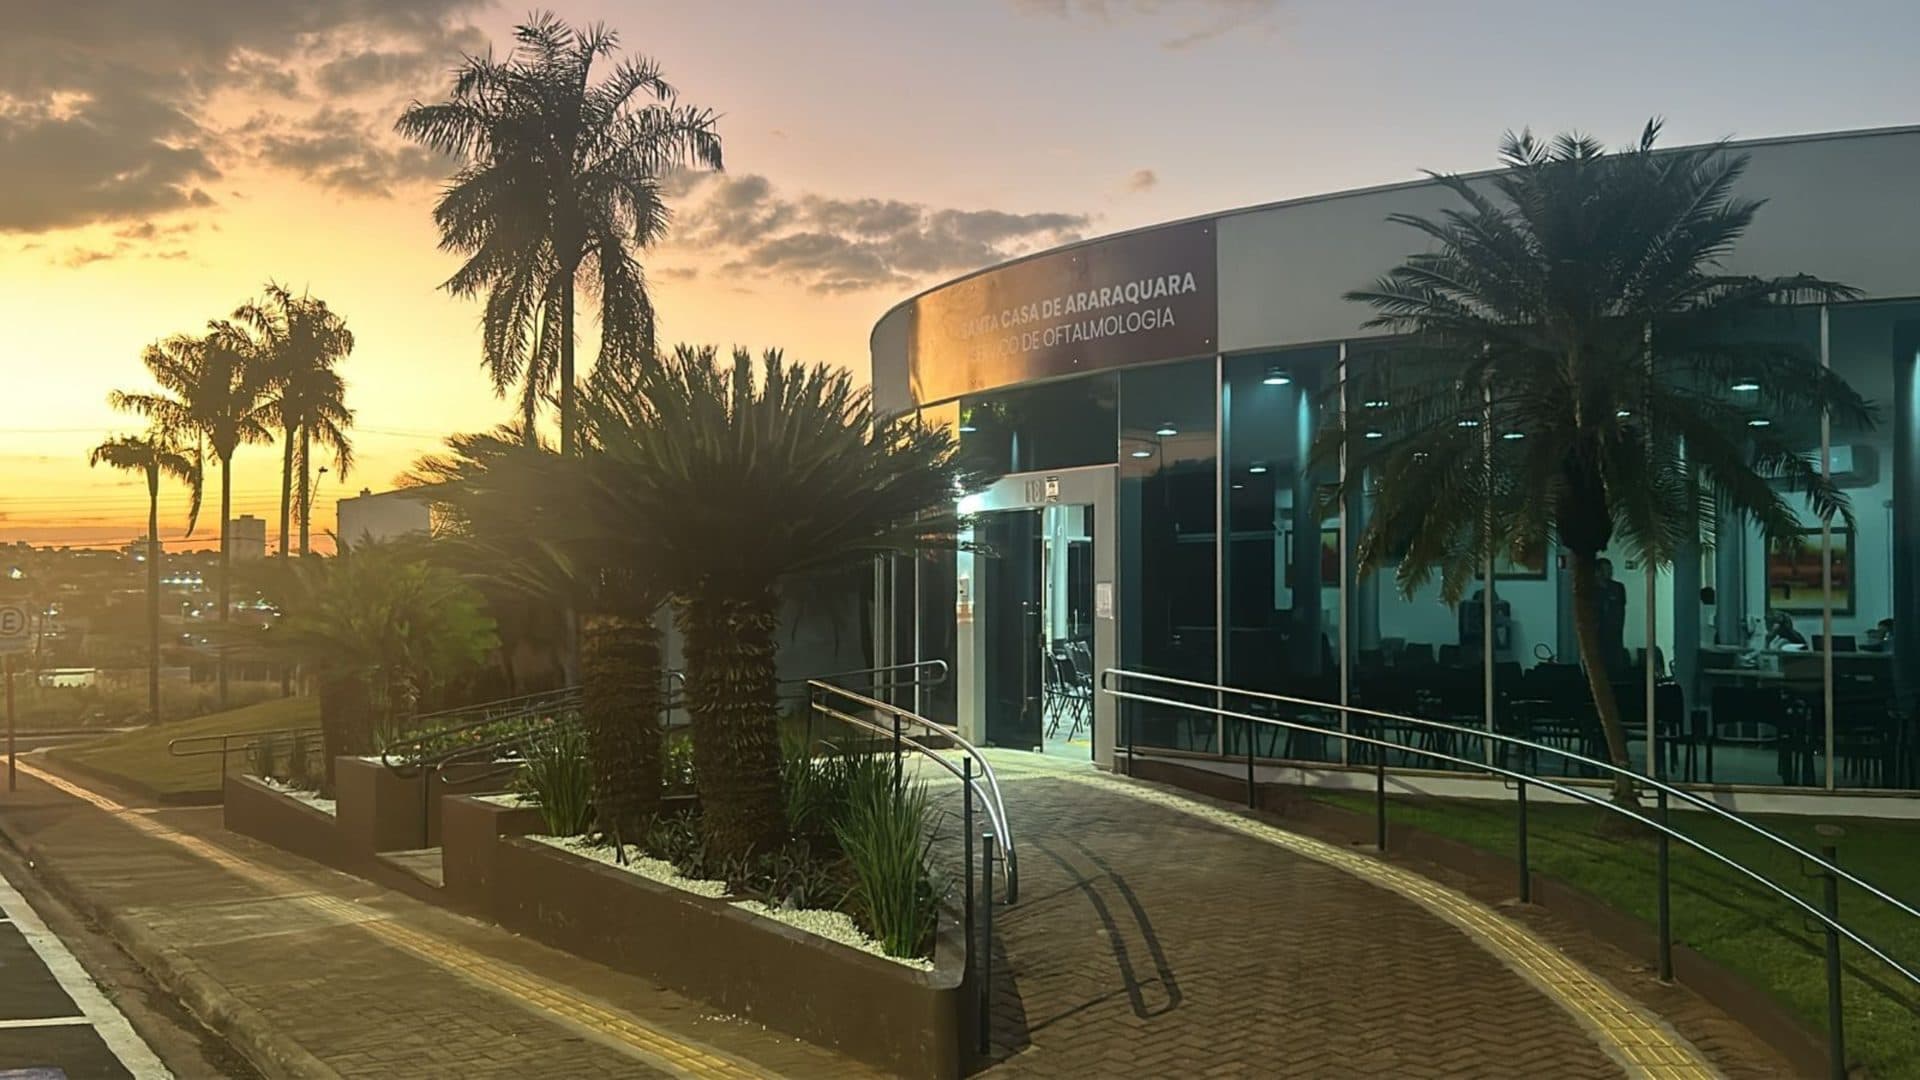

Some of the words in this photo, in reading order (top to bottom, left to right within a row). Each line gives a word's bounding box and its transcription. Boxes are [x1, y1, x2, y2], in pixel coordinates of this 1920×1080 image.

[1001, 303, 1039, 328] CASA
[1042, 298, 1062, 319] DE
[1064, 272, 1197, 315] ARARAQUARA
[1022, 330, 1041, 352] DE
[1043, 306, 1175, 347] OFTALMOLOGIA
[2, 611, 17, 631] E
